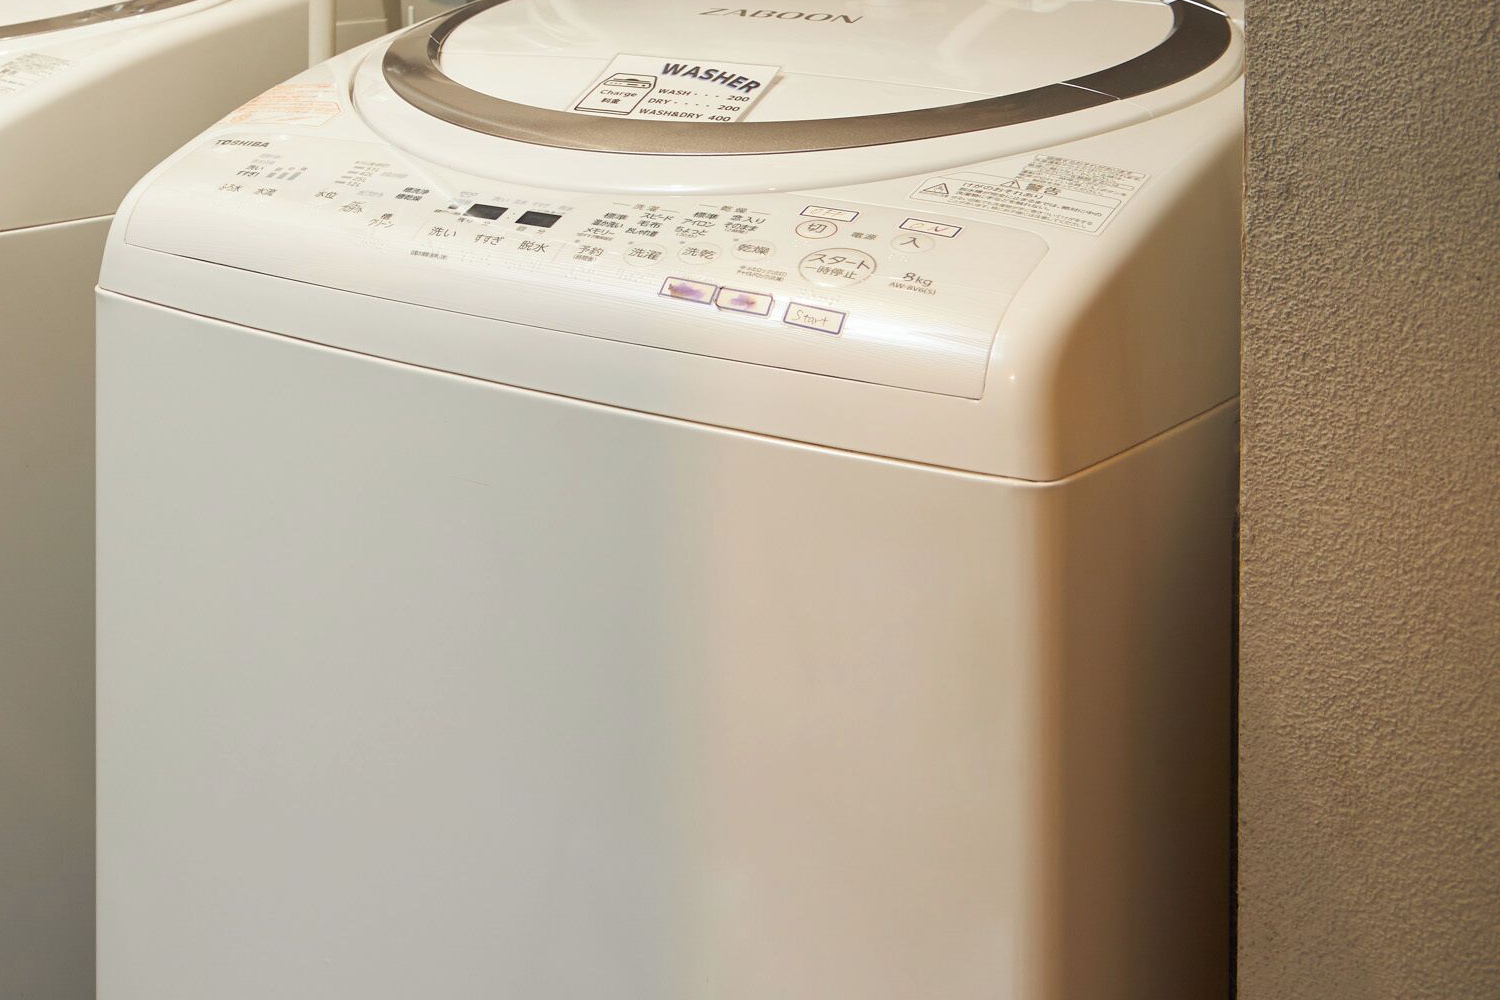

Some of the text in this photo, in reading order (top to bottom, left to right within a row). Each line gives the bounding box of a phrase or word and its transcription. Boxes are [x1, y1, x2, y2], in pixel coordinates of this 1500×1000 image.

[698, 7, 864, 25] ZABOON
[661, 62, 762, 94] WASHER
[600, 88, 638, 99] Charge
[658, 88, 751, 103] WASH 200
[647, 97, 741, 113] DRY 200
[639, 107, 732, 123] WASH&DRY 400
[215, 139, 270, 148] TOSHIBA
[641, 212, 675, 221] スピード
[681, 218, 716, 228] アイロン
[428, 226, 457, 238] 洗い
[583, 227, 615, 236] メモリー
[674, 226, 708, 237] ちょっと
[724, 221, 758, 232] そのまま
[807, 222, 828, 234] 切
[474, 233, 505, 246] すすぎ
[851, 231, 878, 241] 電源
[900, 236, 920, 249] 入
[518, 240, 550, 253] 脱水
[578, 245, 604, 257] 予約
[737, 243, 770, 256] 乾燥
[628, 247, 662, 260] 洗濯
[682, 247, 717, 260] 洗乾
[808, 253, 871, 270] スタート
[805, 265, 858, 281] 一時停止
[902, 272, 933, 287] 8kg
[792, 309, 830, 325] Start
